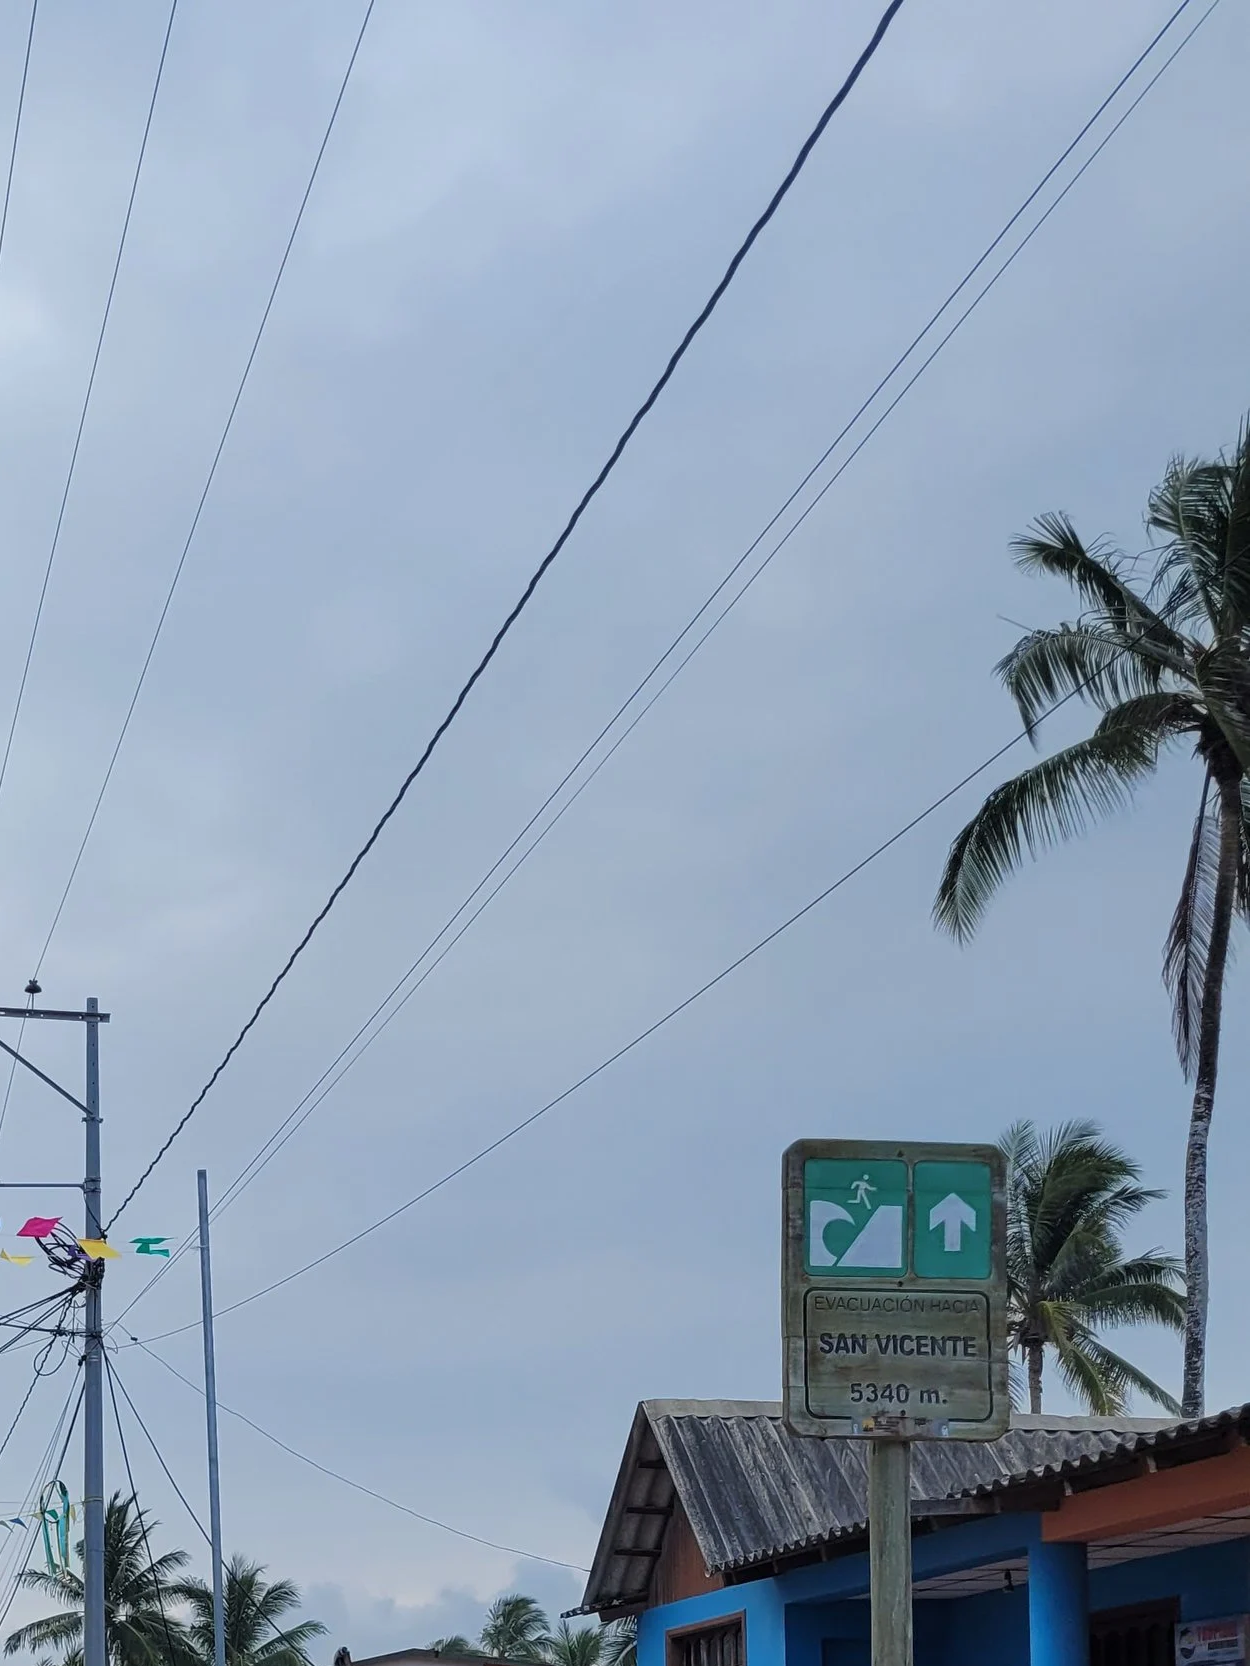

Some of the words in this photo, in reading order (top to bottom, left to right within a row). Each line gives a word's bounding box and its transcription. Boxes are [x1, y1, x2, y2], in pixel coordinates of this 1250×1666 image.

[814, 1295, 925, 1313] EVACUACIÓN
[930, 1298, 980, 1314] HACIA
[819, 1333, 867, 1354] SAN
[875, 1333, 977, 1357] VICENTE
[850, 1383, 910, 1403] 5340
[919, 1389, 948, 1405] m.
